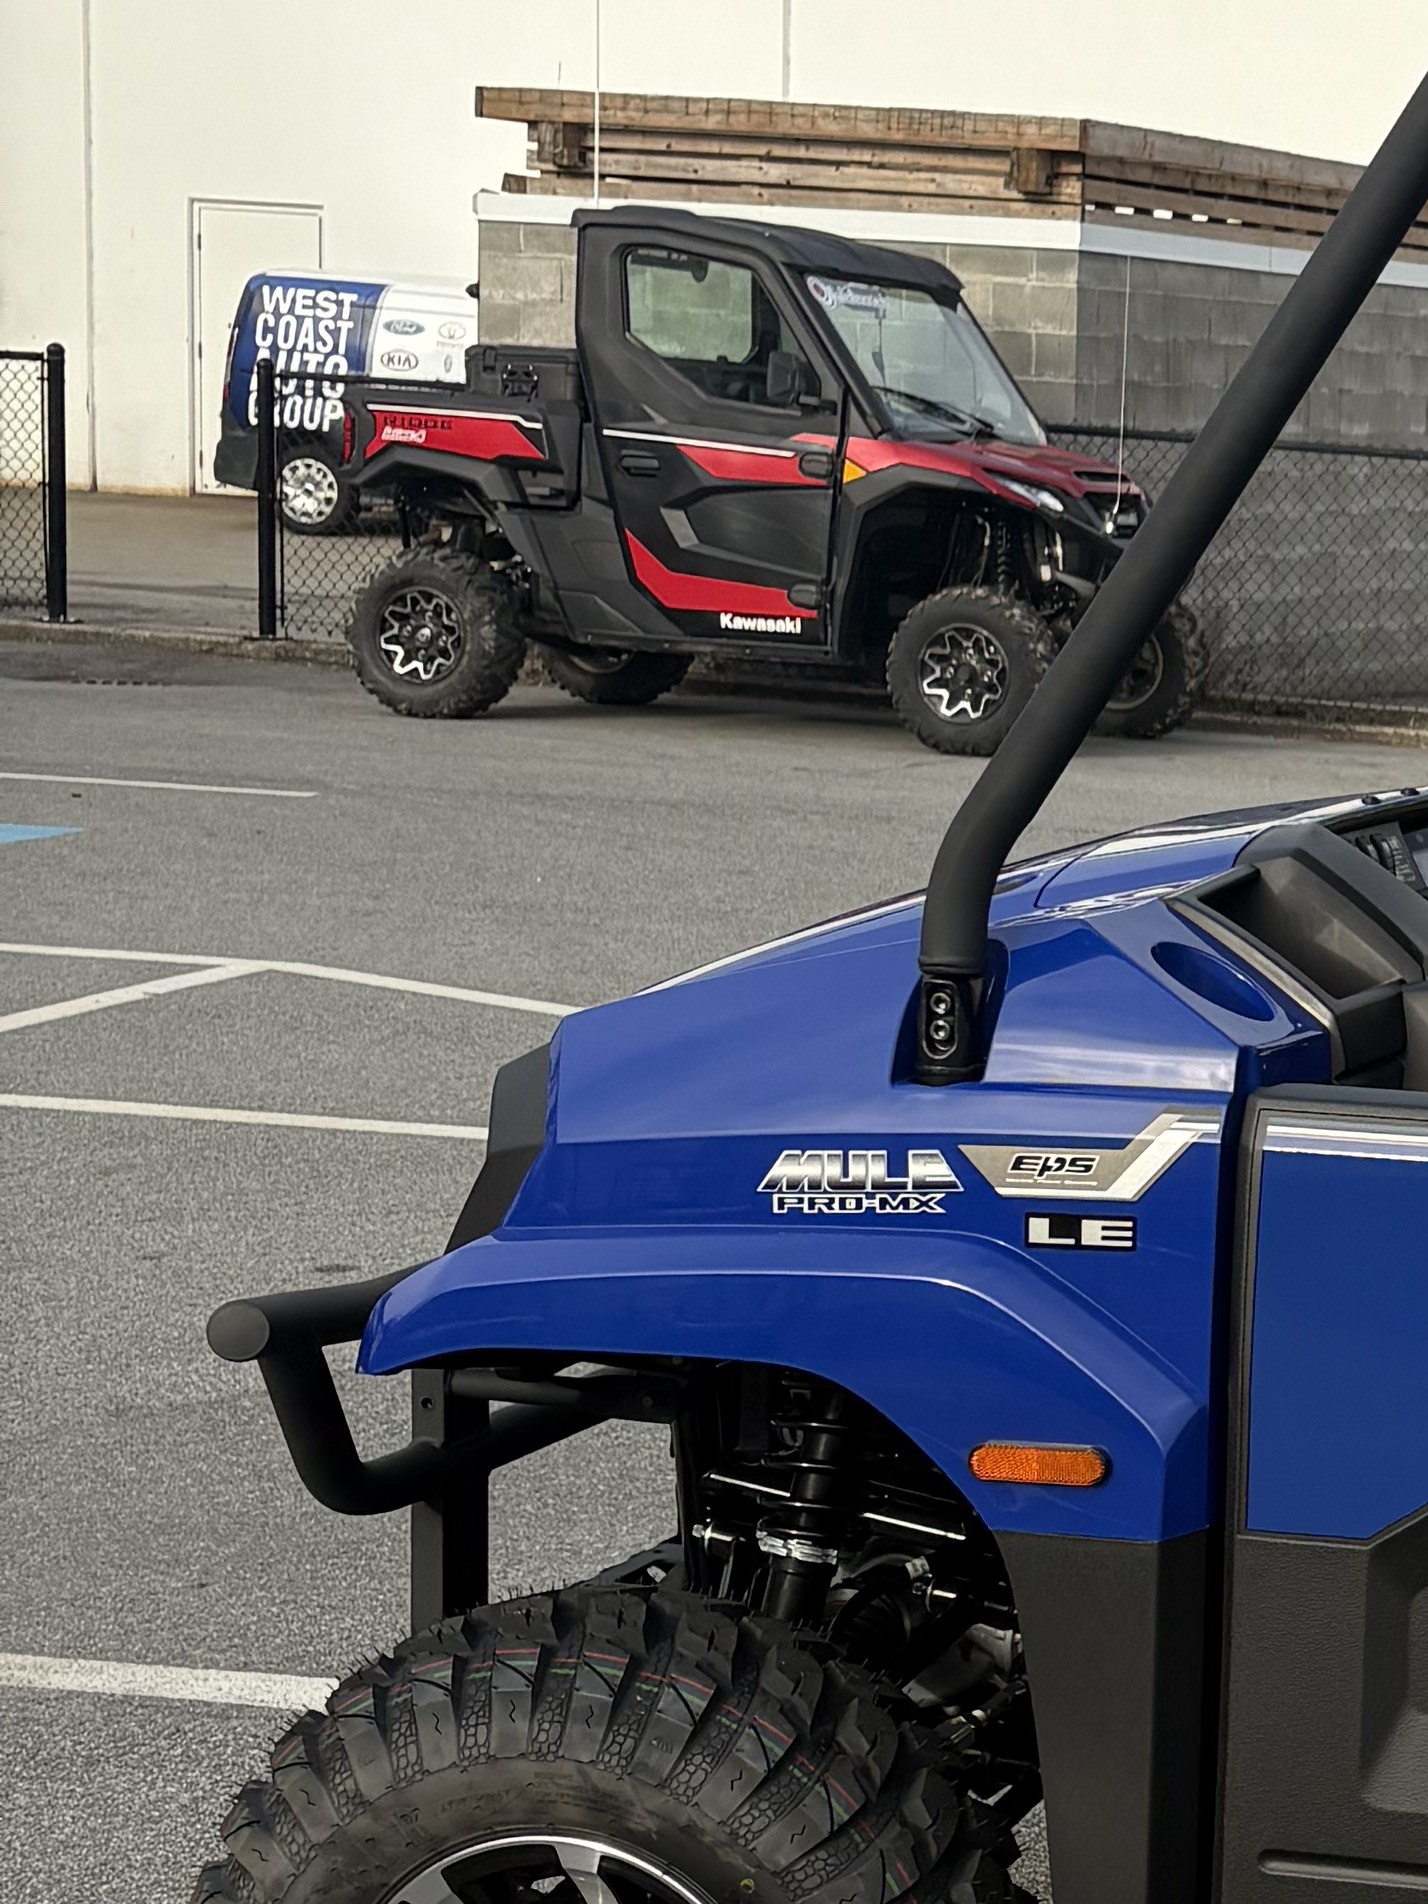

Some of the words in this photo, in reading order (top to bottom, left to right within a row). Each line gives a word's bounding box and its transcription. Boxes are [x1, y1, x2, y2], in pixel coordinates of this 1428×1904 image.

[262, 284, 358, 320] WEST
[255, 313, 354, 355] COAST
[385, 351, 413, 369] KIA
[719, 612, 802, 634] Kawasaki
[756, 1149, 965, 1192] MULE
[772, 1193, 947, 1214] PRO-MX
[1027, 1217, 1134, 1248] LE
